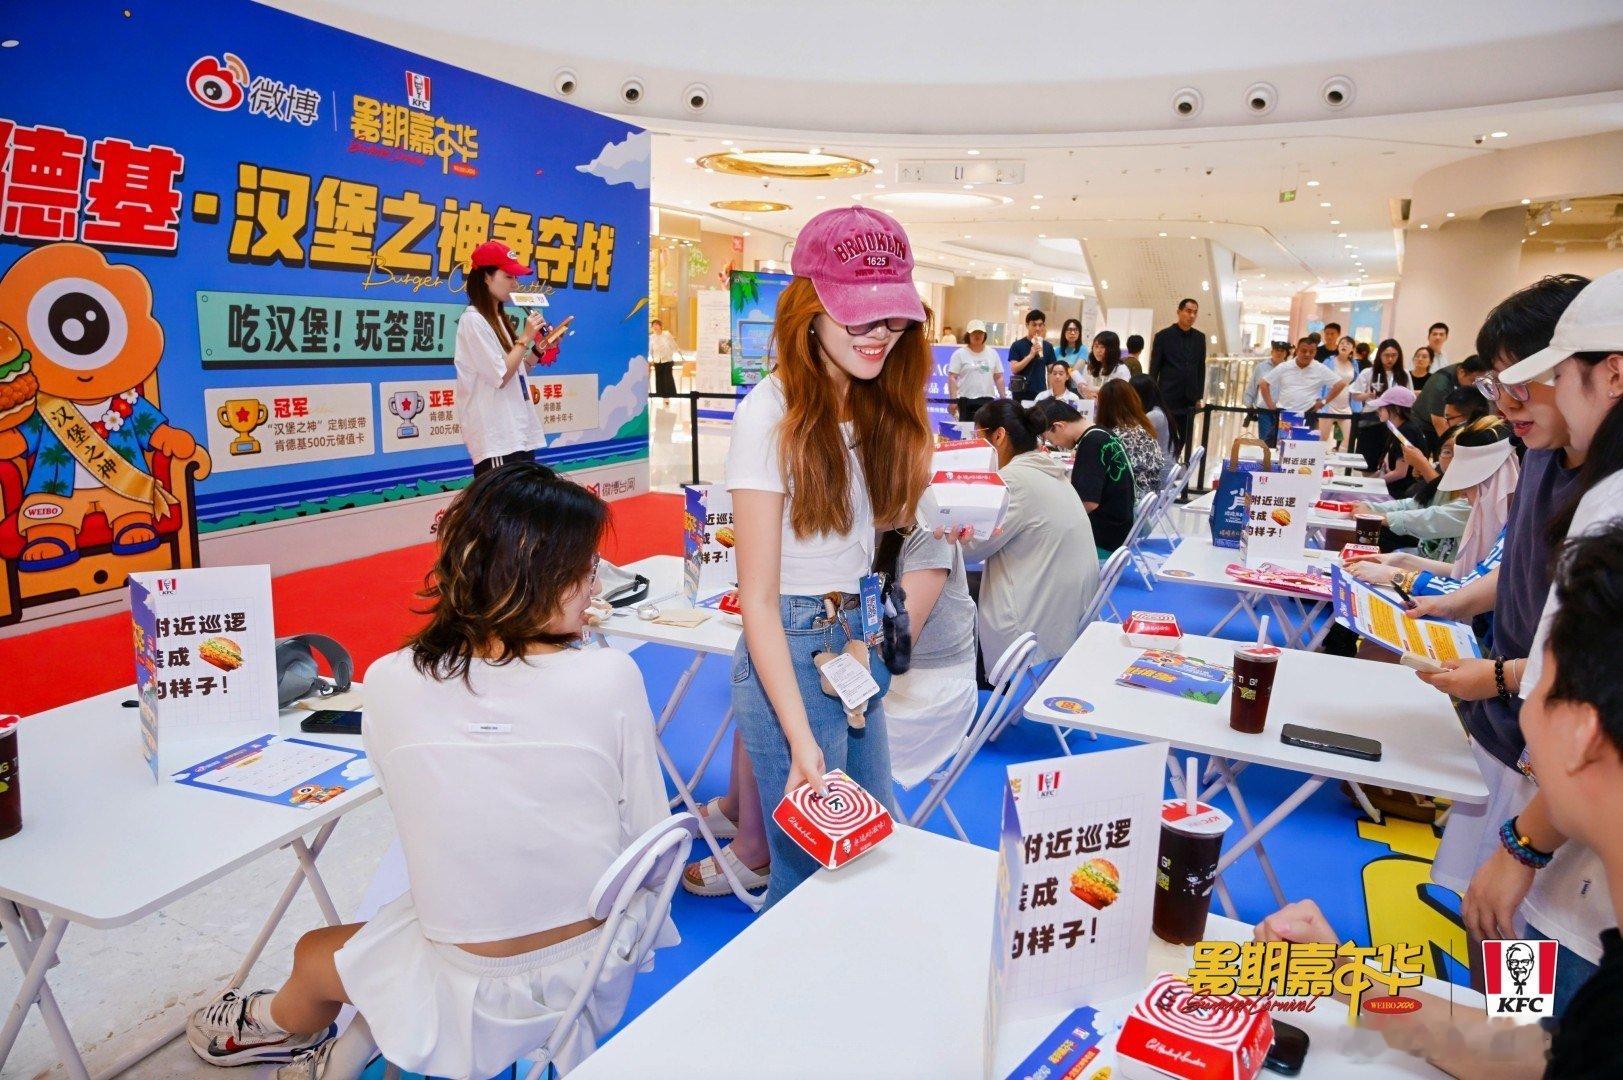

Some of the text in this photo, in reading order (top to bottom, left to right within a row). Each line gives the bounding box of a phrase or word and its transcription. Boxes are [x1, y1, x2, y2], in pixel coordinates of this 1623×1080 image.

[249, 78, 320, 126] 微博
[411, 98, 428, 110] KFC
[350, 95, 479, 174] 暑期嘉年华
[866, 256, 886, 266] 1625
[361, 252, 444, 294] Burger
[429, 389, 455, 408] 亚军
[543, 384, 563, 400] 季军
[273, 397, 310, 419] 冠军
[543, 402, 562, 412] 肯德基
[430, 411, 454, 422] 肯德基
[430, 425, 463, 436] 200元储
[50, 405, 118, 481] 汉堡之神
[274, 434, 366, 452] 肯德基500元储值卡
[27, 507, 59, 517] WEIBO
[1040, 789, 1055, 798] KFC
